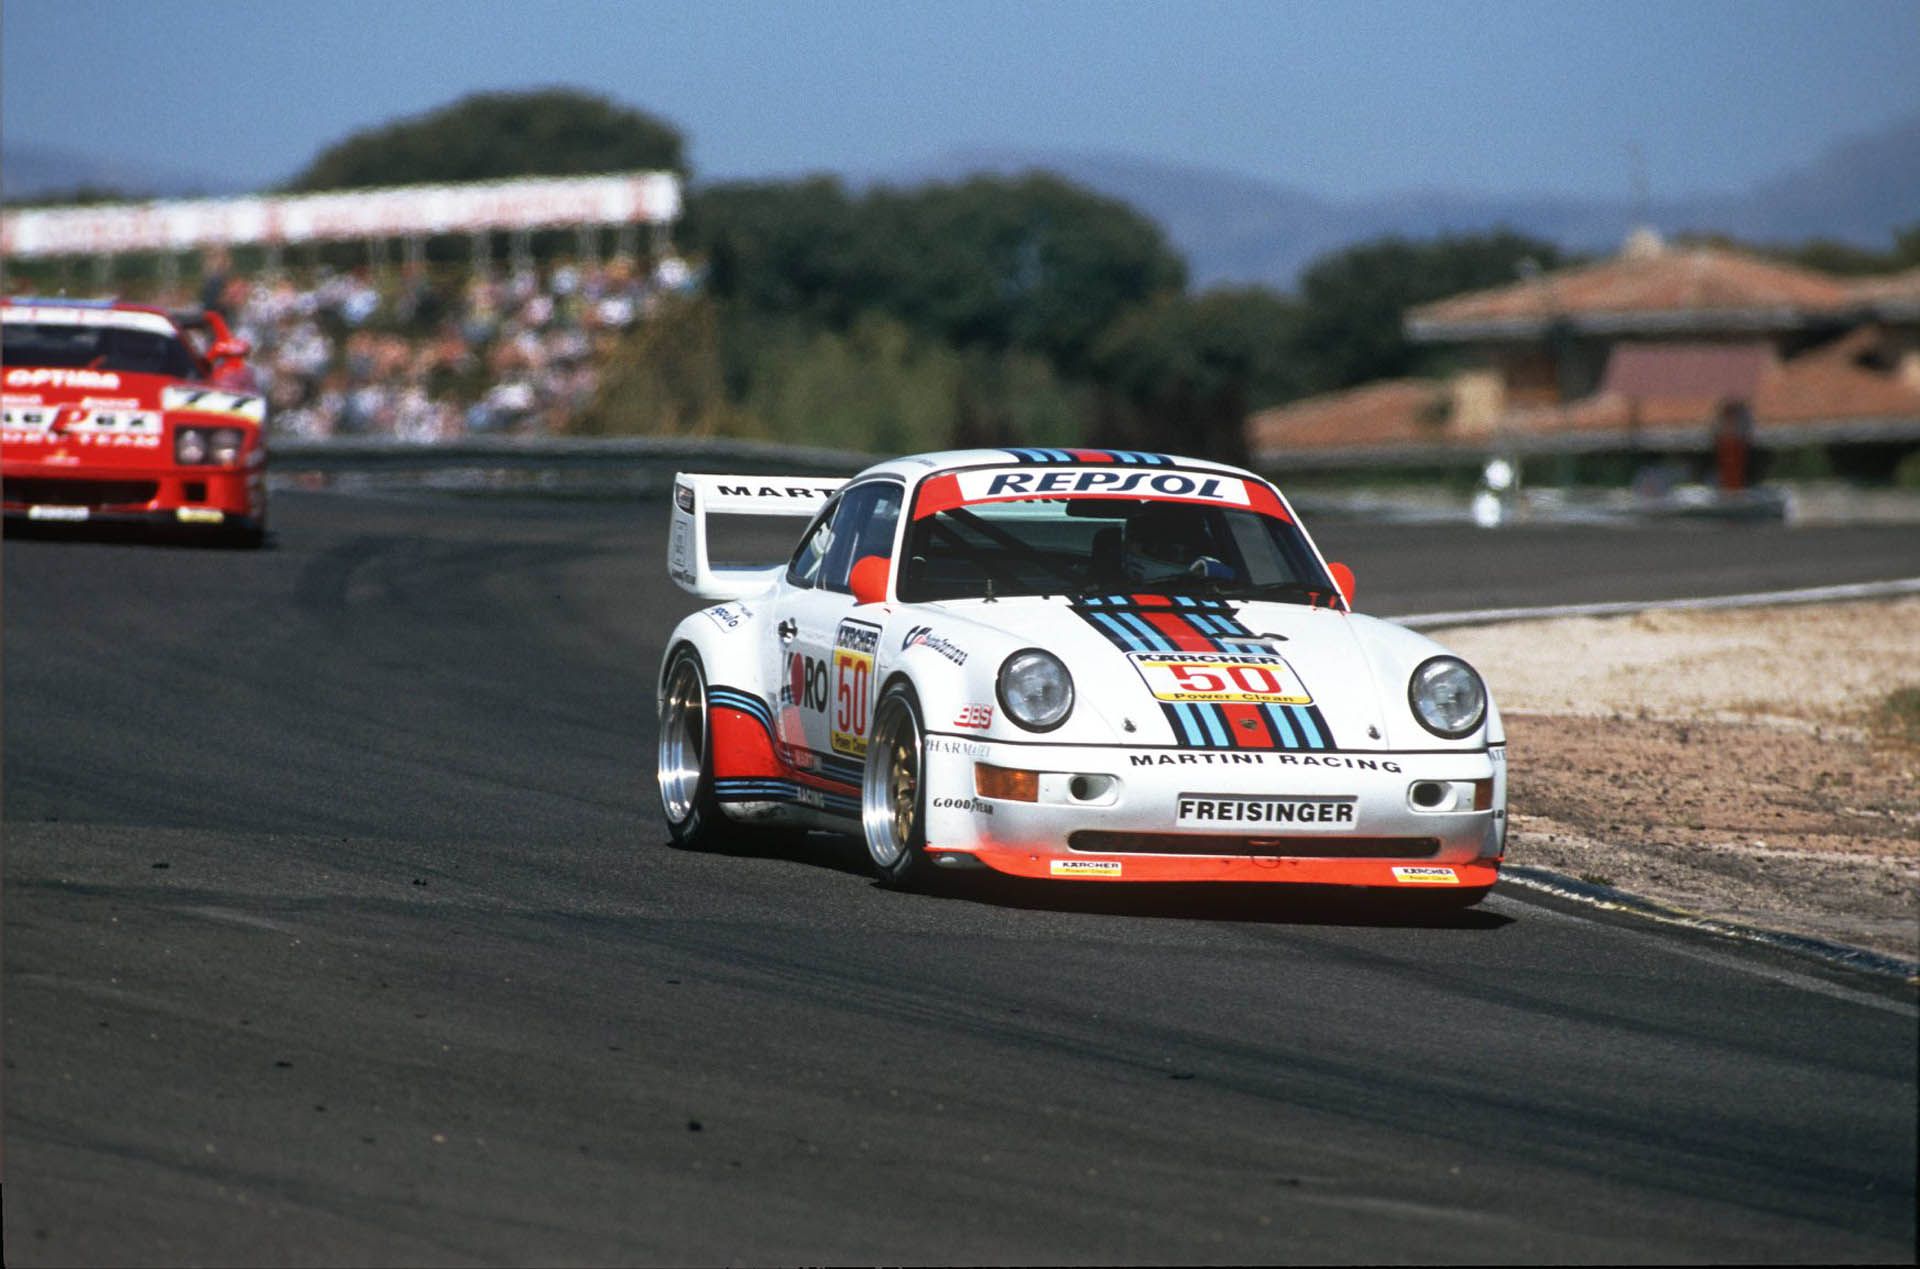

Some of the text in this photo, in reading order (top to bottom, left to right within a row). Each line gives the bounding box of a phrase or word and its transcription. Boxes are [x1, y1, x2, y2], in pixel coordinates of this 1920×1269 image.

[987, 471, 1225, 499] REPSOL
[1168, 664, 1282, 694] 50
[837, 655, 868, 736] 50
[1242, 693, 1294, 702] Clean
[953, 703, 994, 730] BBS
[1129, 754, 1402, 773] MARTINI RACING
[1179, 800, 1353, 822] FREISINGER
